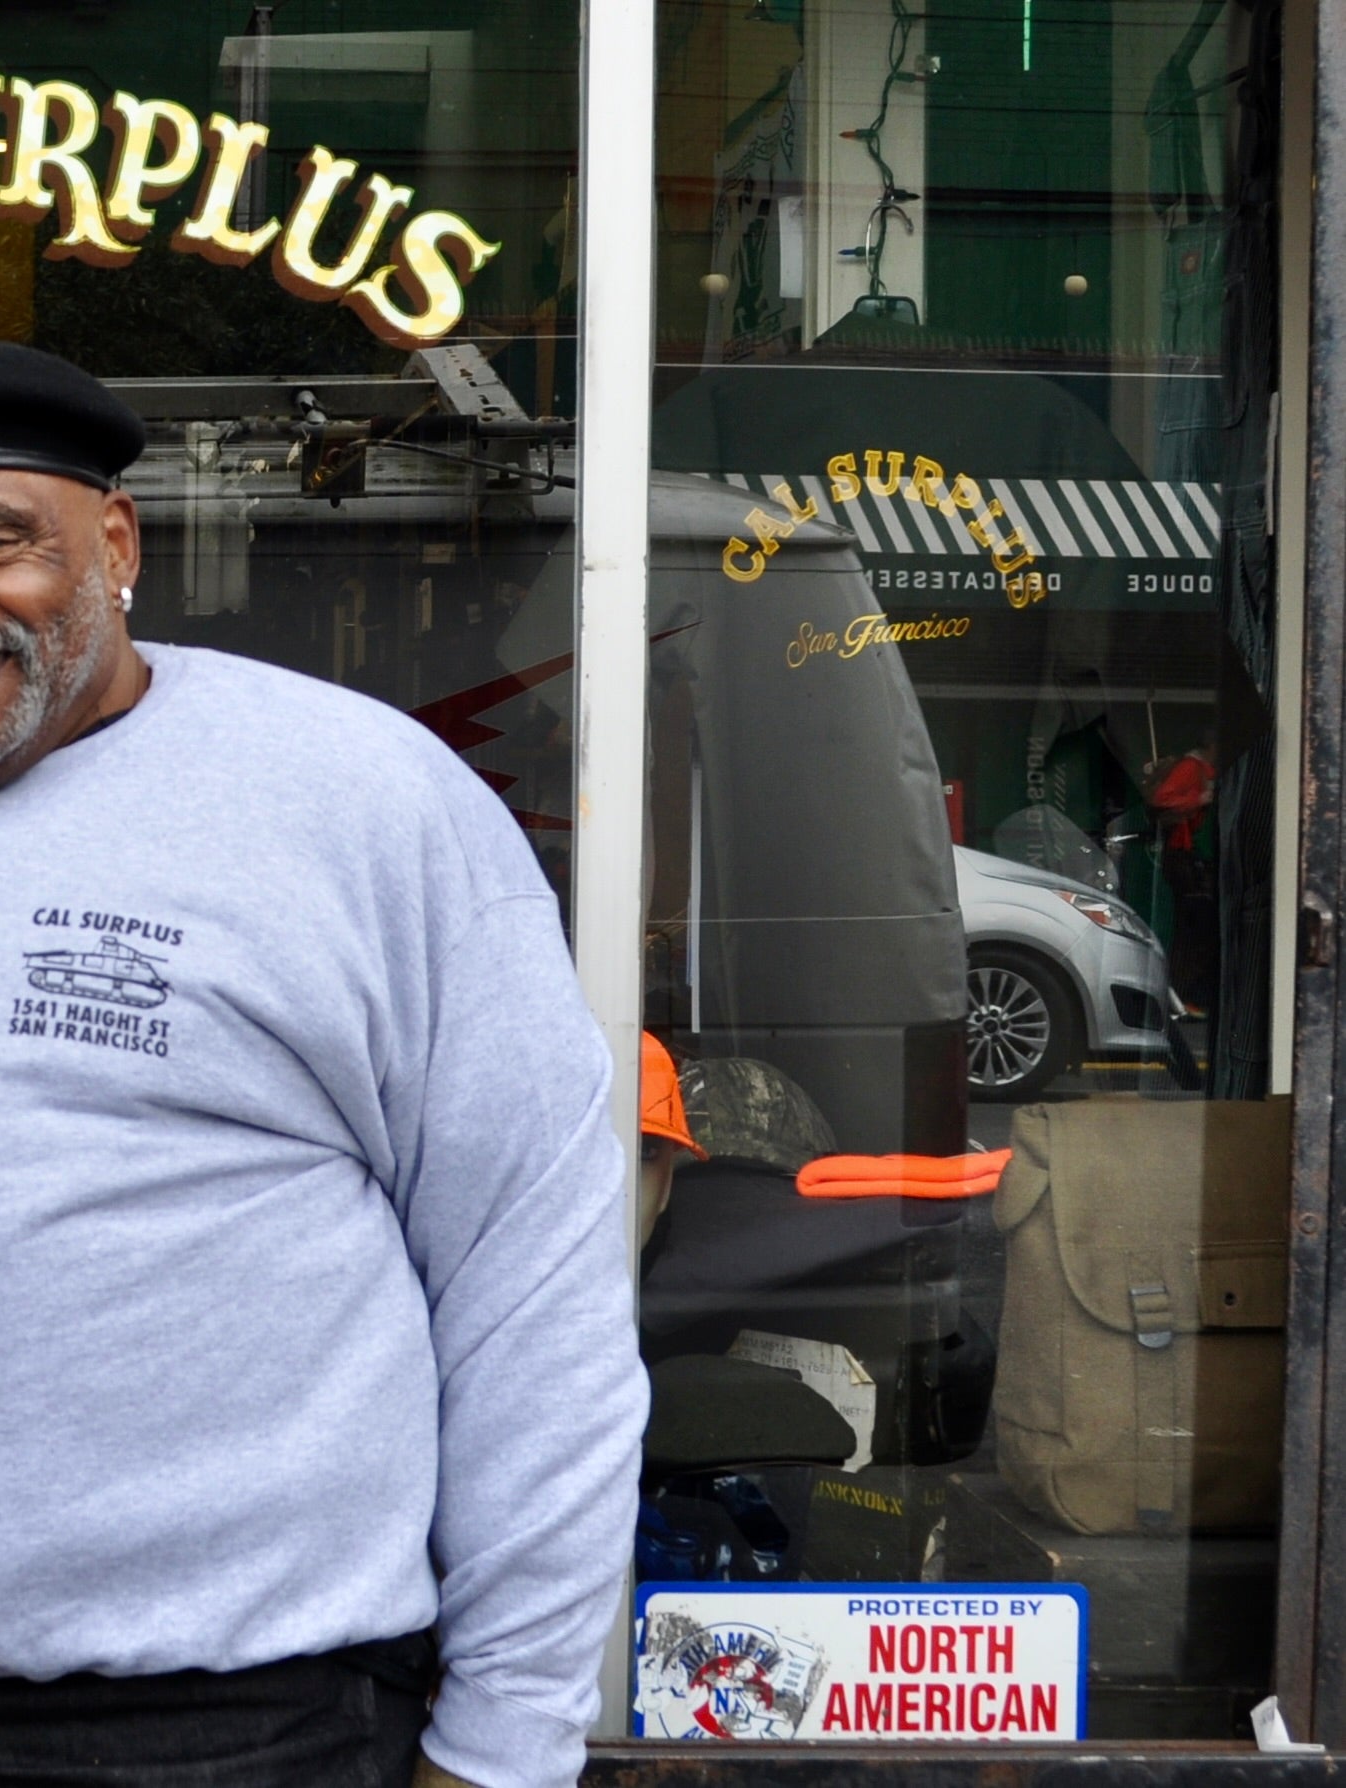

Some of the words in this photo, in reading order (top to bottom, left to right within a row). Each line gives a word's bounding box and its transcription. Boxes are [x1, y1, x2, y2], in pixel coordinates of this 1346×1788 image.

[721, 482, 819, 584] CAL
[826, 448, 1048, 610] SURPLUS
[786, 621, 837, 668] San
[838, 613, 971, 660] Francisco
[32, 907, 71, 927] CAL
[79, 911, 184, 946] SURPLUS
[8, 1017, 47, 1037] SAN
[54, 1022, 169, 1058] FRANCISCO
[12, 998, 57, 1018] 1541
[66, 1003, 142, 1033] HAIGHT
[149, 1020, 171, 1038] ST
[848, 1599, 999, 1616] PROTECTED
[1010, 1599, 1043, 1616] BY
[868, 1624, 1014, 1674] NORTH
[821, 1683, 1058, 1733] AMERICAN
